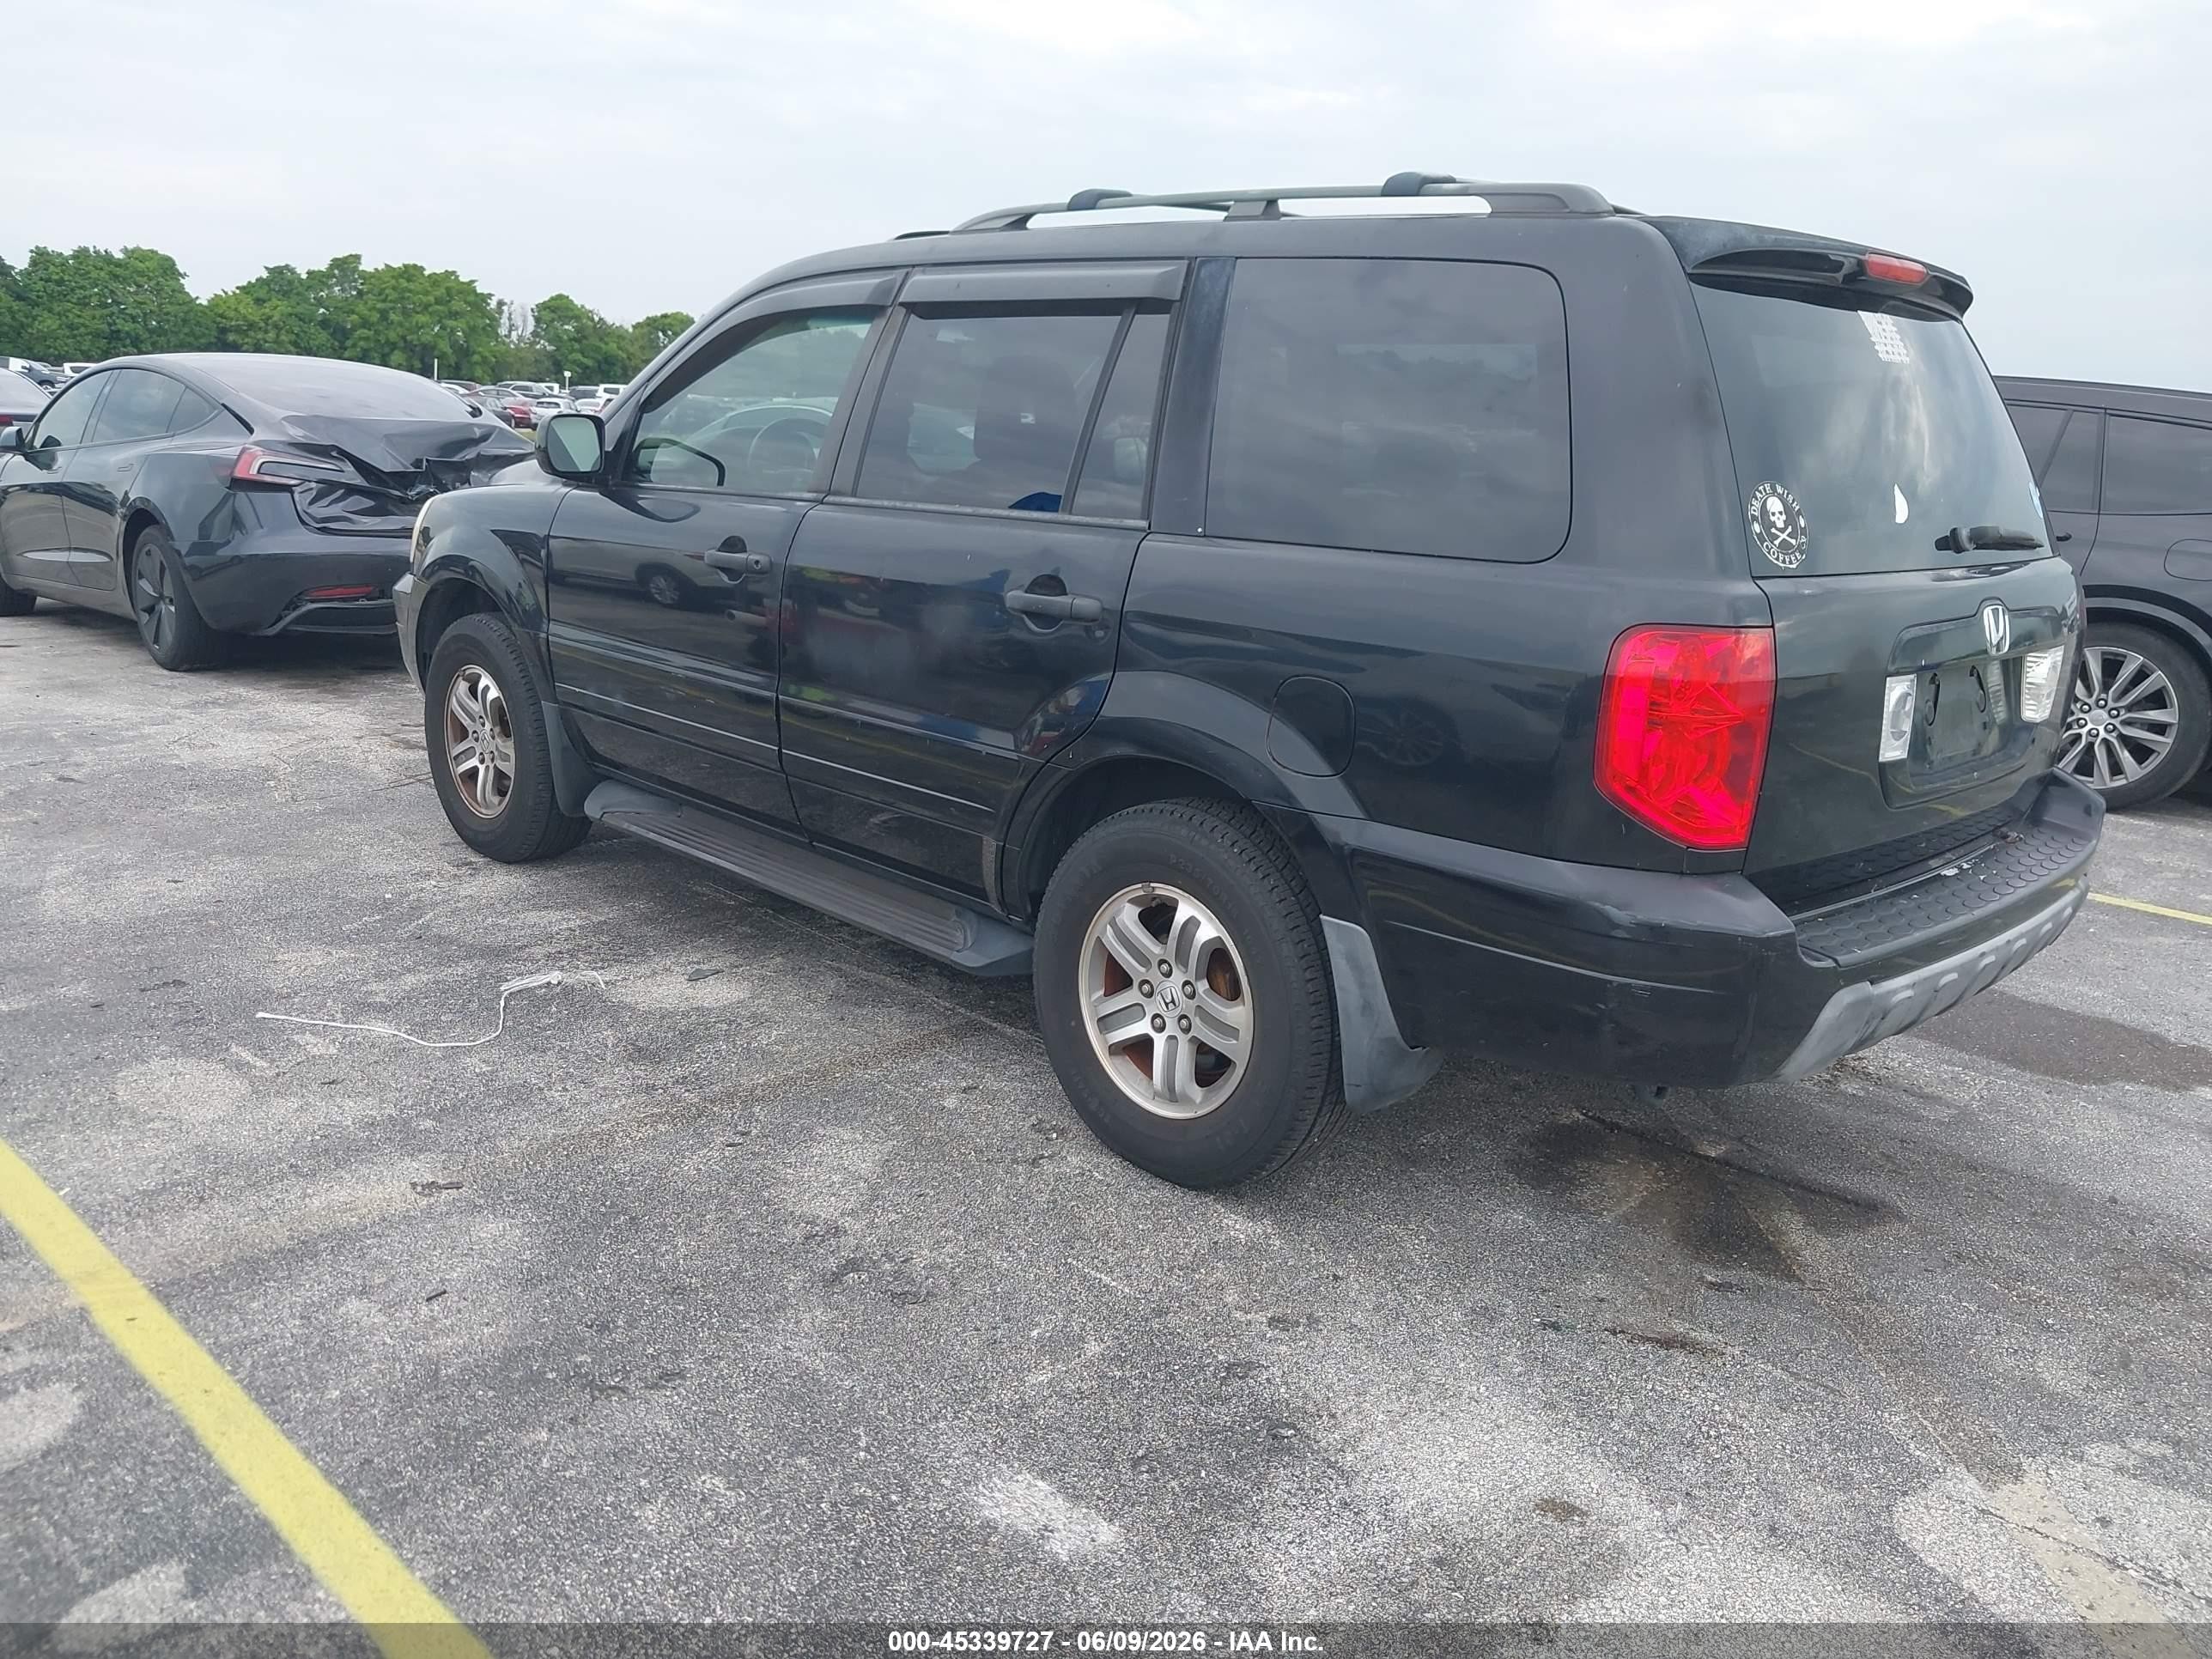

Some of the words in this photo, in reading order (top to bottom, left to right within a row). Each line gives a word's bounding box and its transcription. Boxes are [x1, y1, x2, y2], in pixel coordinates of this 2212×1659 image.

[1752, 483, 1773, 516] DEATH
[1775, 484, 1800, 511] WISH
[1763, 542, 1802, 564] COFFEE
